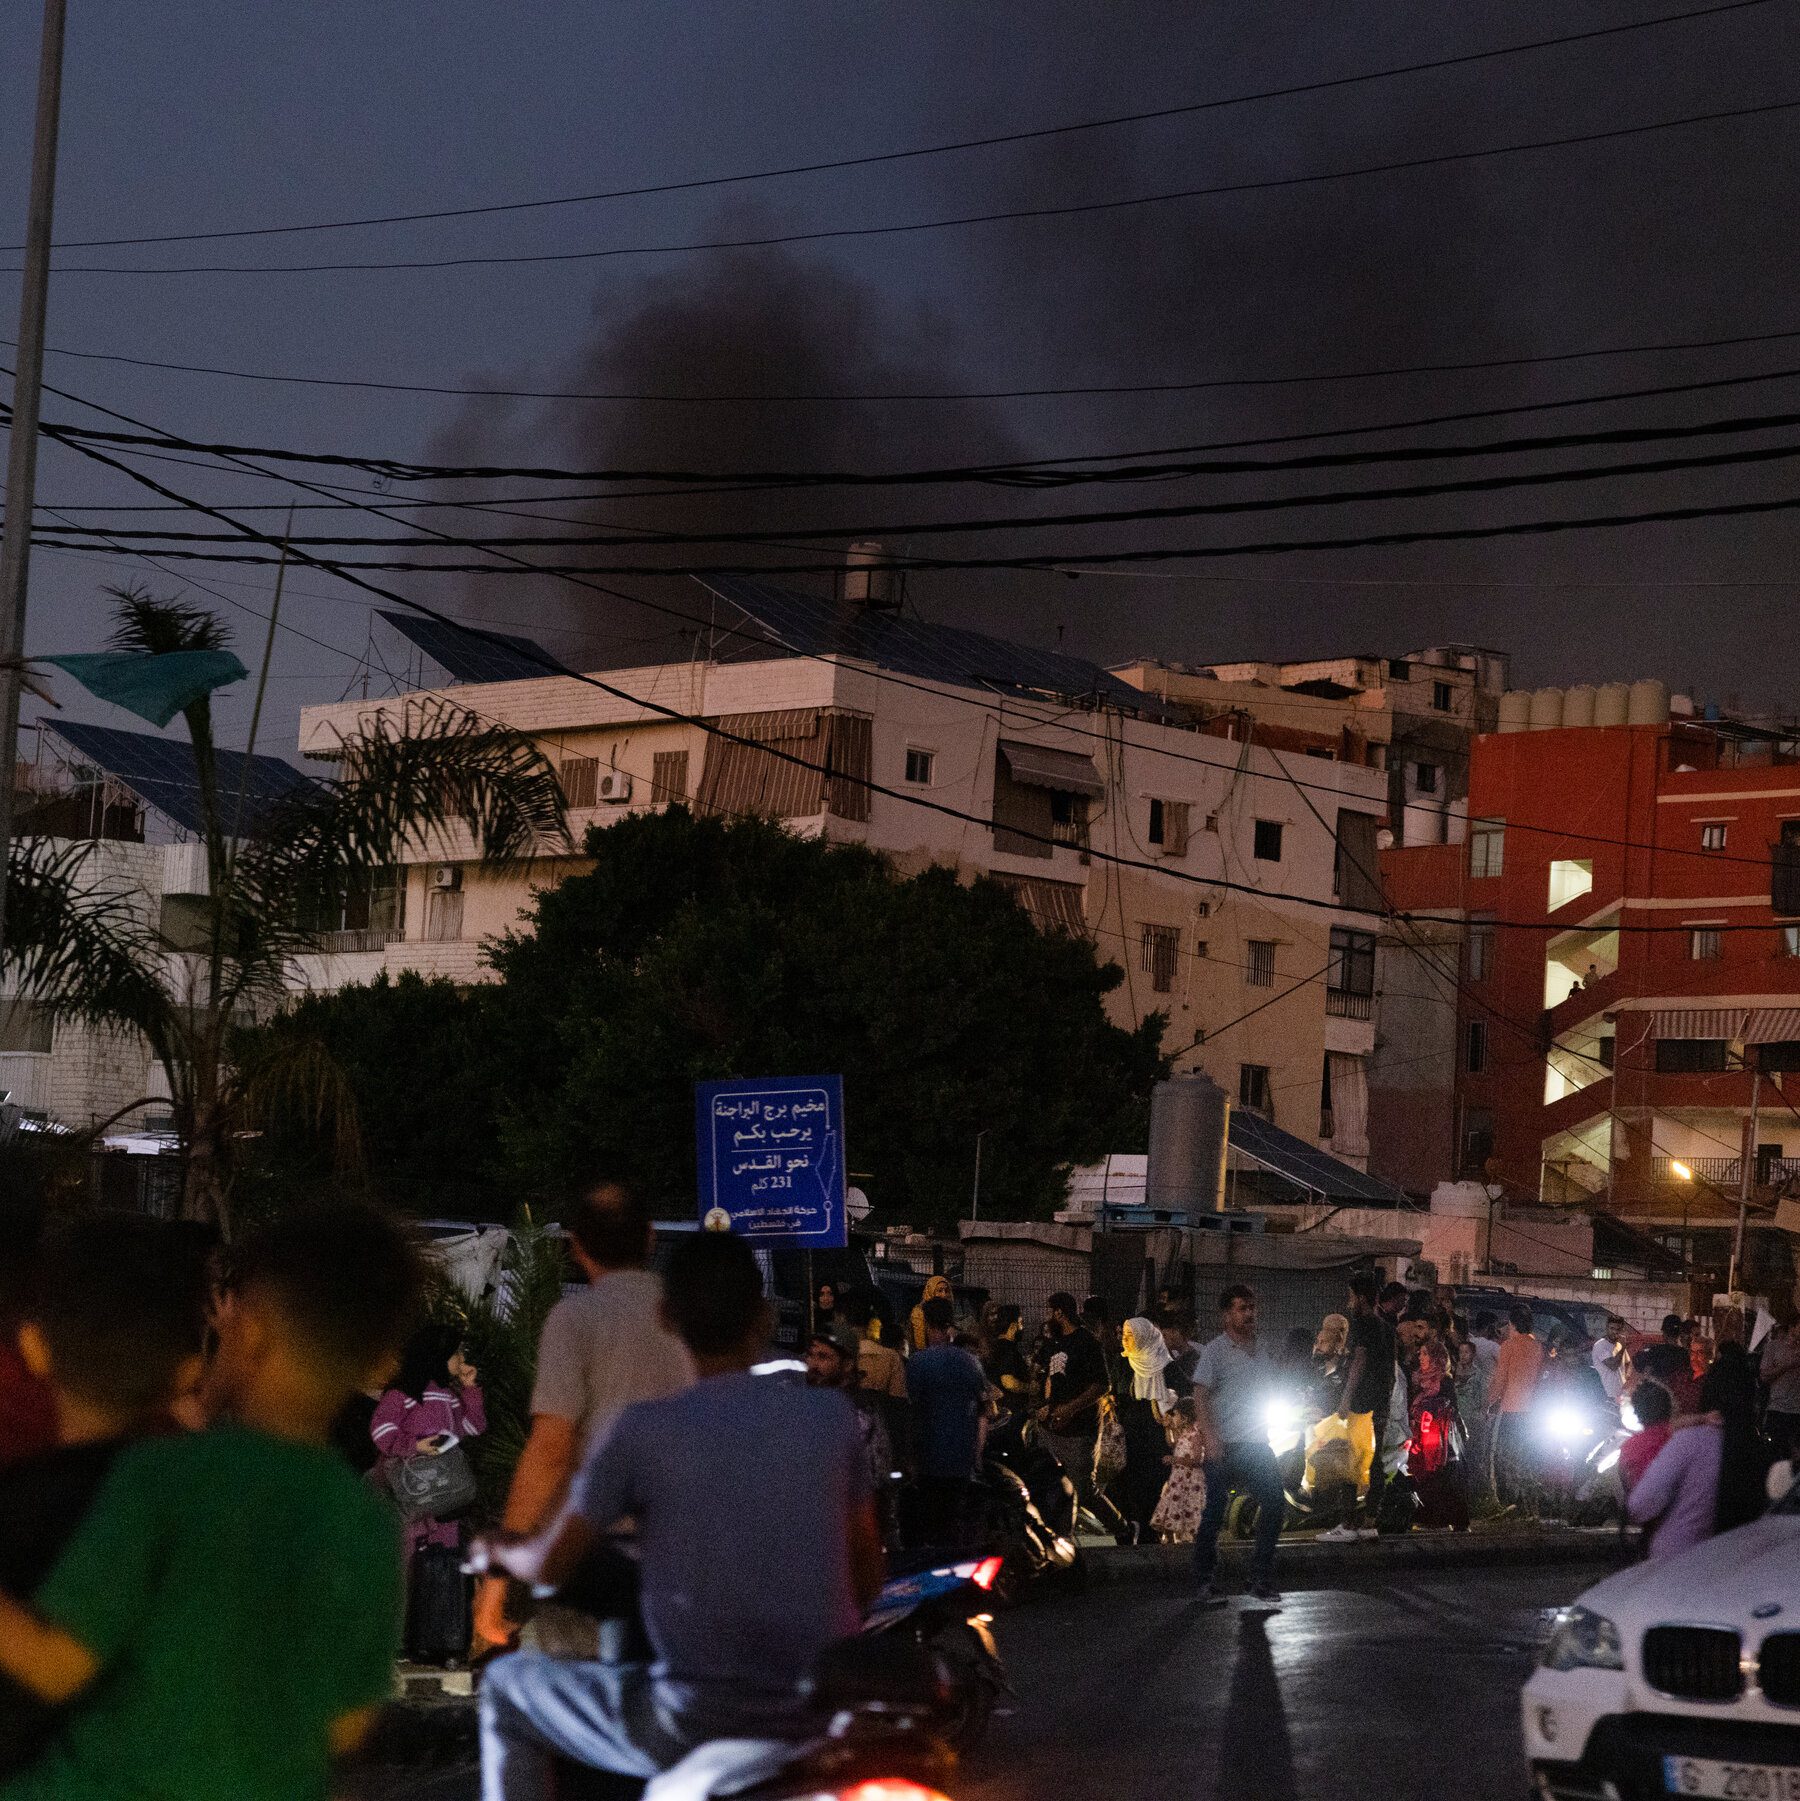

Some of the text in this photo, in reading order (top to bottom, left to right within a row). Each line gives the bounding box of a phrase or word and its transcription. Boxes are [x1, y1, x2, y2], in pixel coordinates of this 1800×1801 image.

[715, 1098, 826, 1121] مخيم برج البراجنة
[733, 1123, 813, 1148] يرحب بكم
[732, 1154, 809, 1175] نحو القدس
[750, 1176, 793, 1196] 231 كلم
